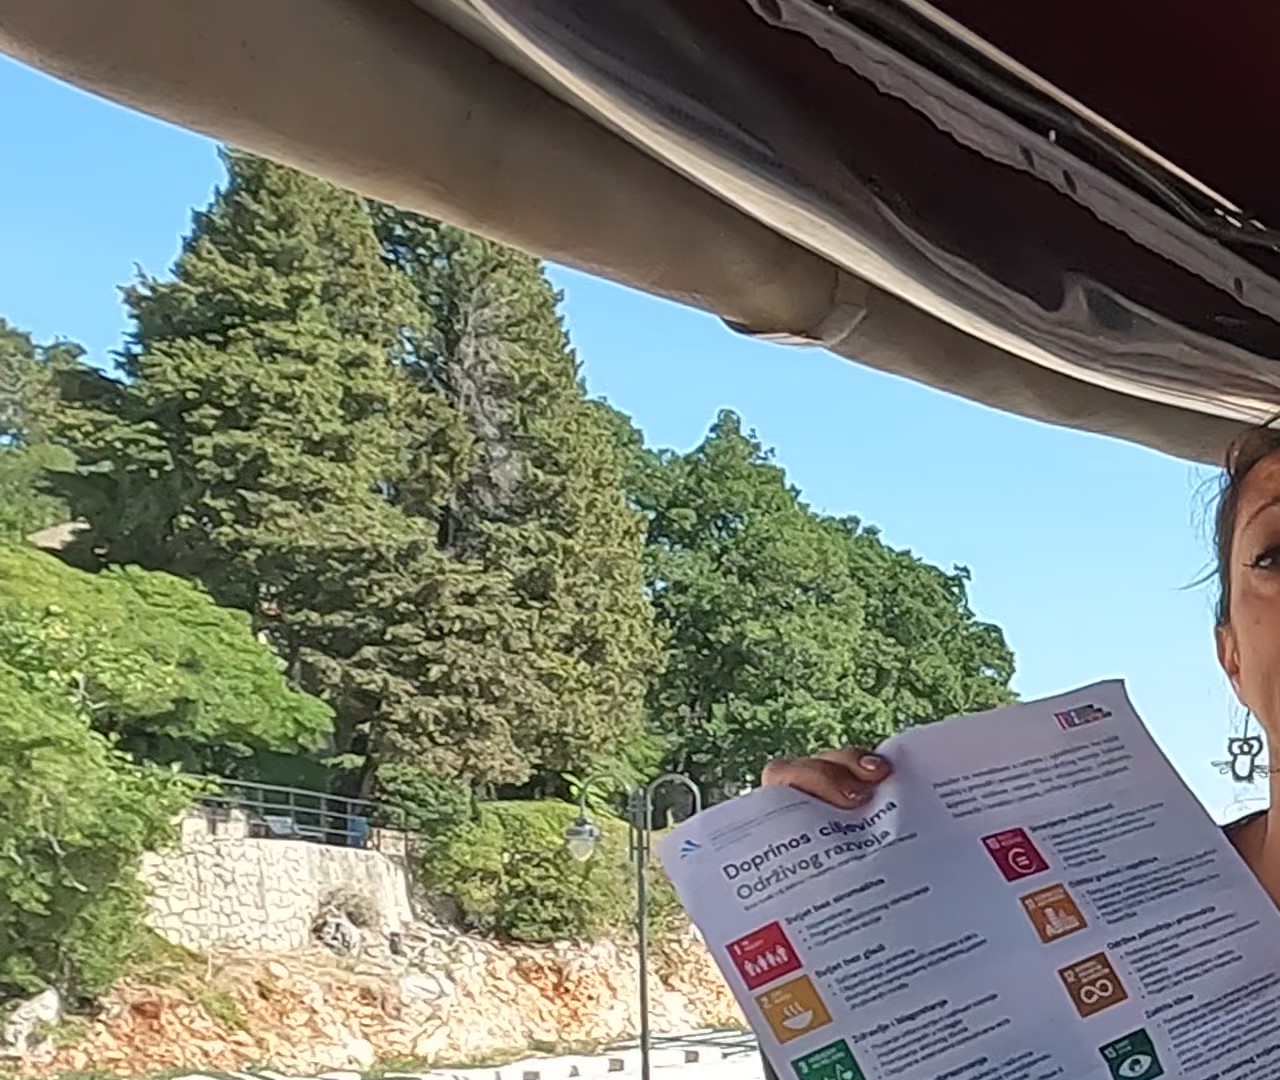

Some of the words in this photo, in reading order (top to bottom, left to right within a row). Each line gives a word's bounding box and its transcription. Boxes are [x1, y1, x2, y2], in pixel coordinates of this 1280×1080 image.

[723, 834, 812, 880] Doprinos
[819, 801, 897, 837] ciljevima
[736, 852, 823, 900] Održivog
[824, 829, 890, 861] razvoja
